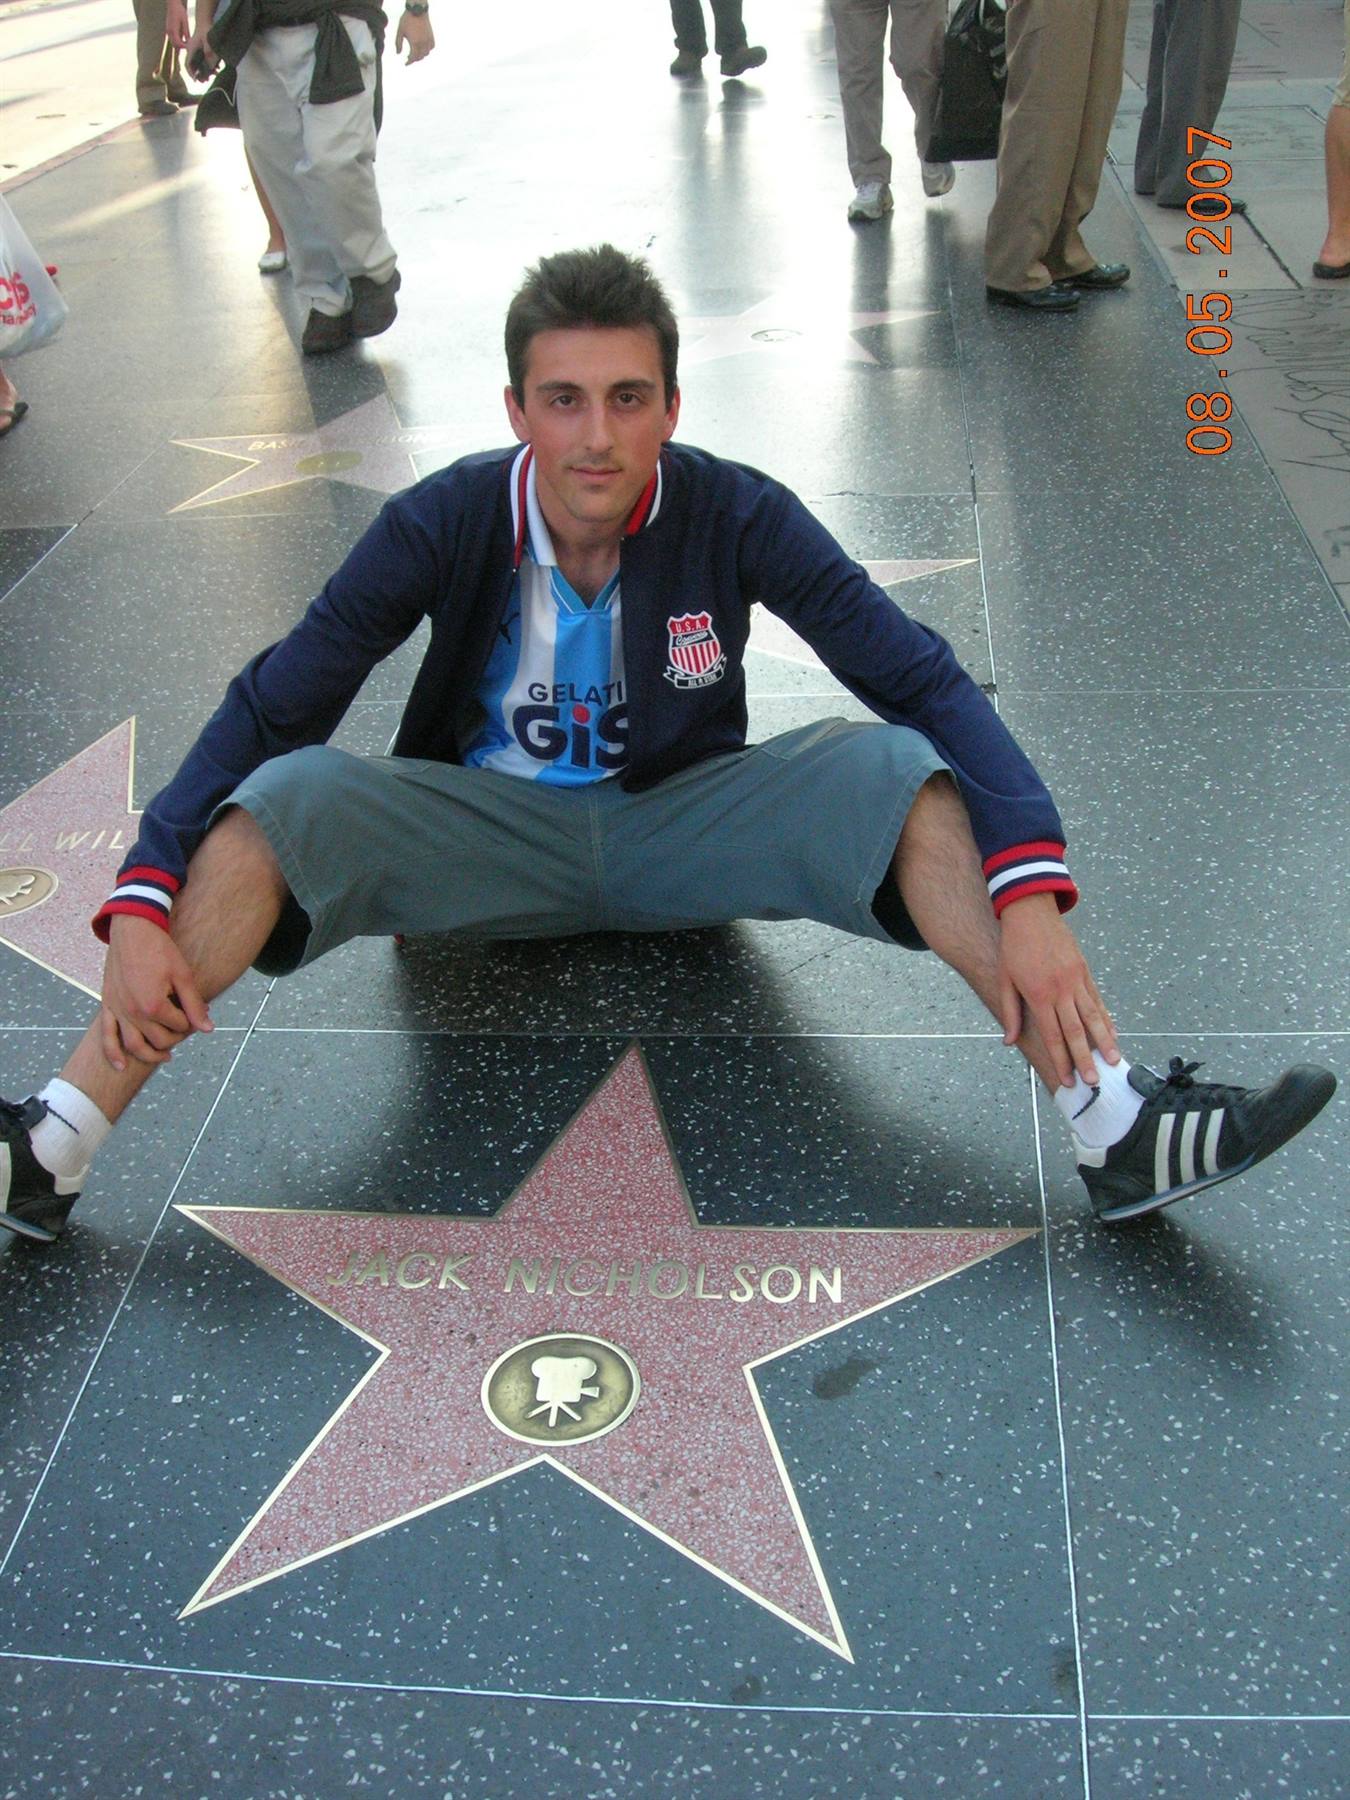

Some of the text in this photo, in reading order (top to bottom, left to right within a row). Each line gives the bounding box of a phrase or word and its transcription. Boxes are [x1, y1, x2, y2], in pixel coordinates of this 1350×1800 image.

[528, 680, 623, 706] GELATI
[324, 1249, 843, 1304] JACK NICHOLSON
